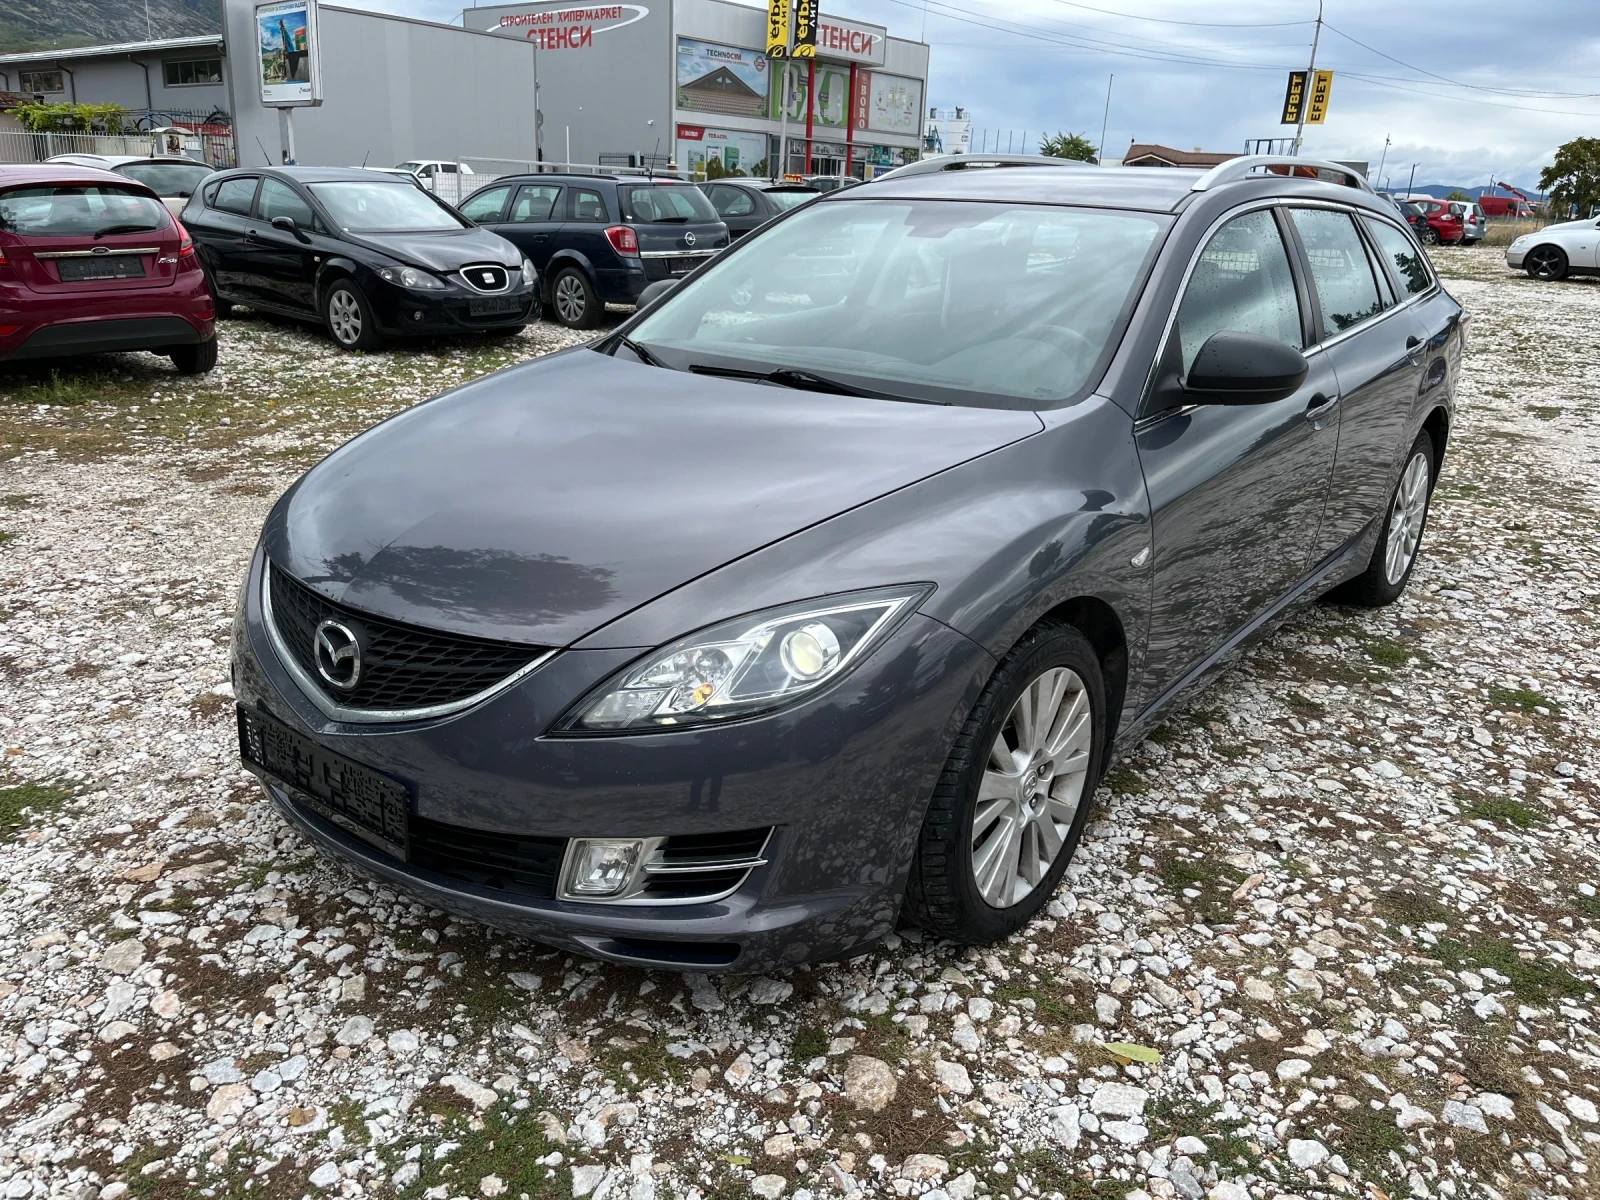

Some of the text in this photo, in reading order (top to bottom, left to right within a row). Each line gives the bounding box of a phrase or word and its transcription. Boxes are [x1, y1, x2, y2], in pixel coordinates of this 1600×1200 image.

[500, 6, 623, 28] СТРОИТЕЛЕН ХИПЕРМАРКЕТ
[809, 0, 817, 28] ЛИГ
[705, 48, 742, 61] TECHNOCIM
[816, 23, 873, 56] ТЕНСИ
[858, 84, 868, 129] BORO
[1285, 74, 1303, 122] EFBET
[1310, 74, 1328, 122] EFBET
